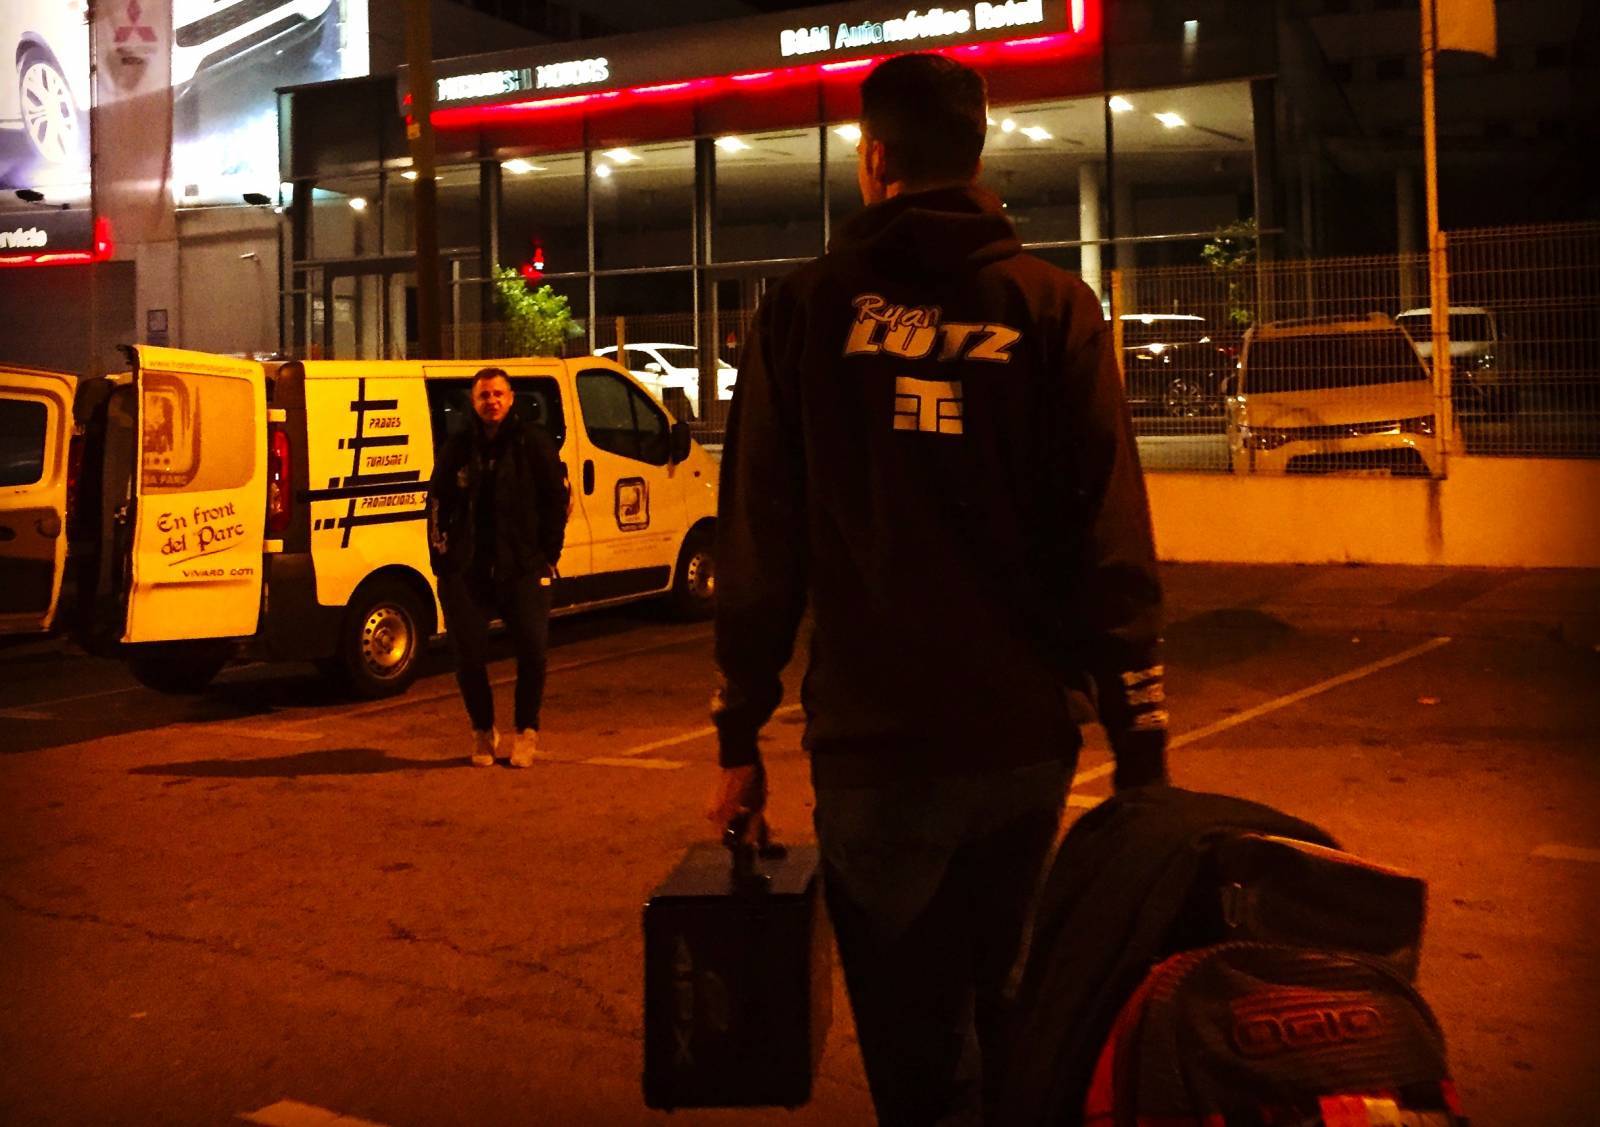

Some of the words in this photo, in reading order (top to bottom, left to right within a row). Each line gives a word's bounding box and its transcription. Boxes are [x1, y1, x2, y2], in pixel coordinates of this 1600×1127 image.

[854, 294, 940, 331] Ryan
[844, 317, 1023, 363] LUTZ
[366, 454, 402, 468] TURISME
[157, 512, 188, 533] En
[193, 502, 236, 525] front
[160, 534, 187, 555] del
[196, 523, 245, 553] Parc
